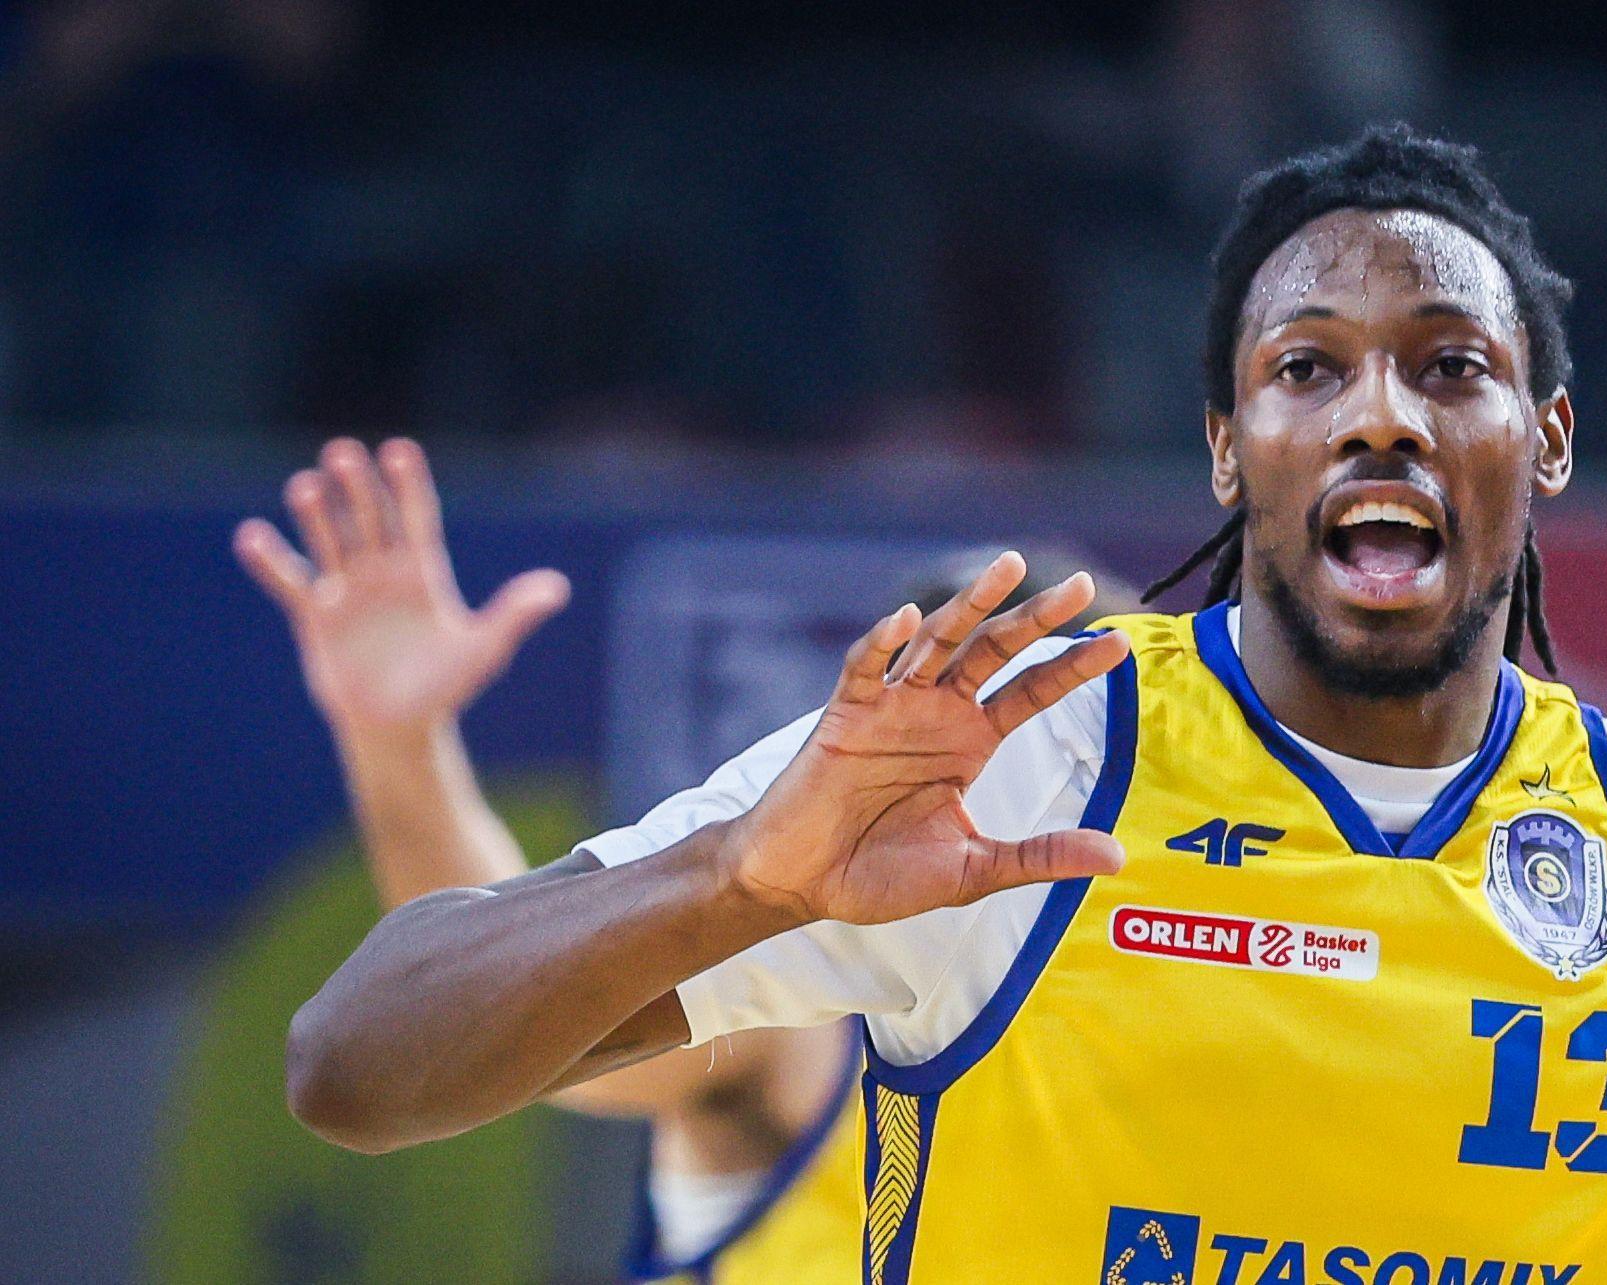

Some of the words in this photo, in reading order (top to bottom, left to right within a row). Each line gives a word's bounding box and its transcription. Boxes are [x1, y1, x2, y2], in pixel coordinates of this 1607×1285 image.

[1165, 818, 1286, 867] 4F
[1123, 917, 1240, 954] ORLEN
[1303, 930, 1368, 953] Basket
[1303, 950, 1341, 971] Liga
